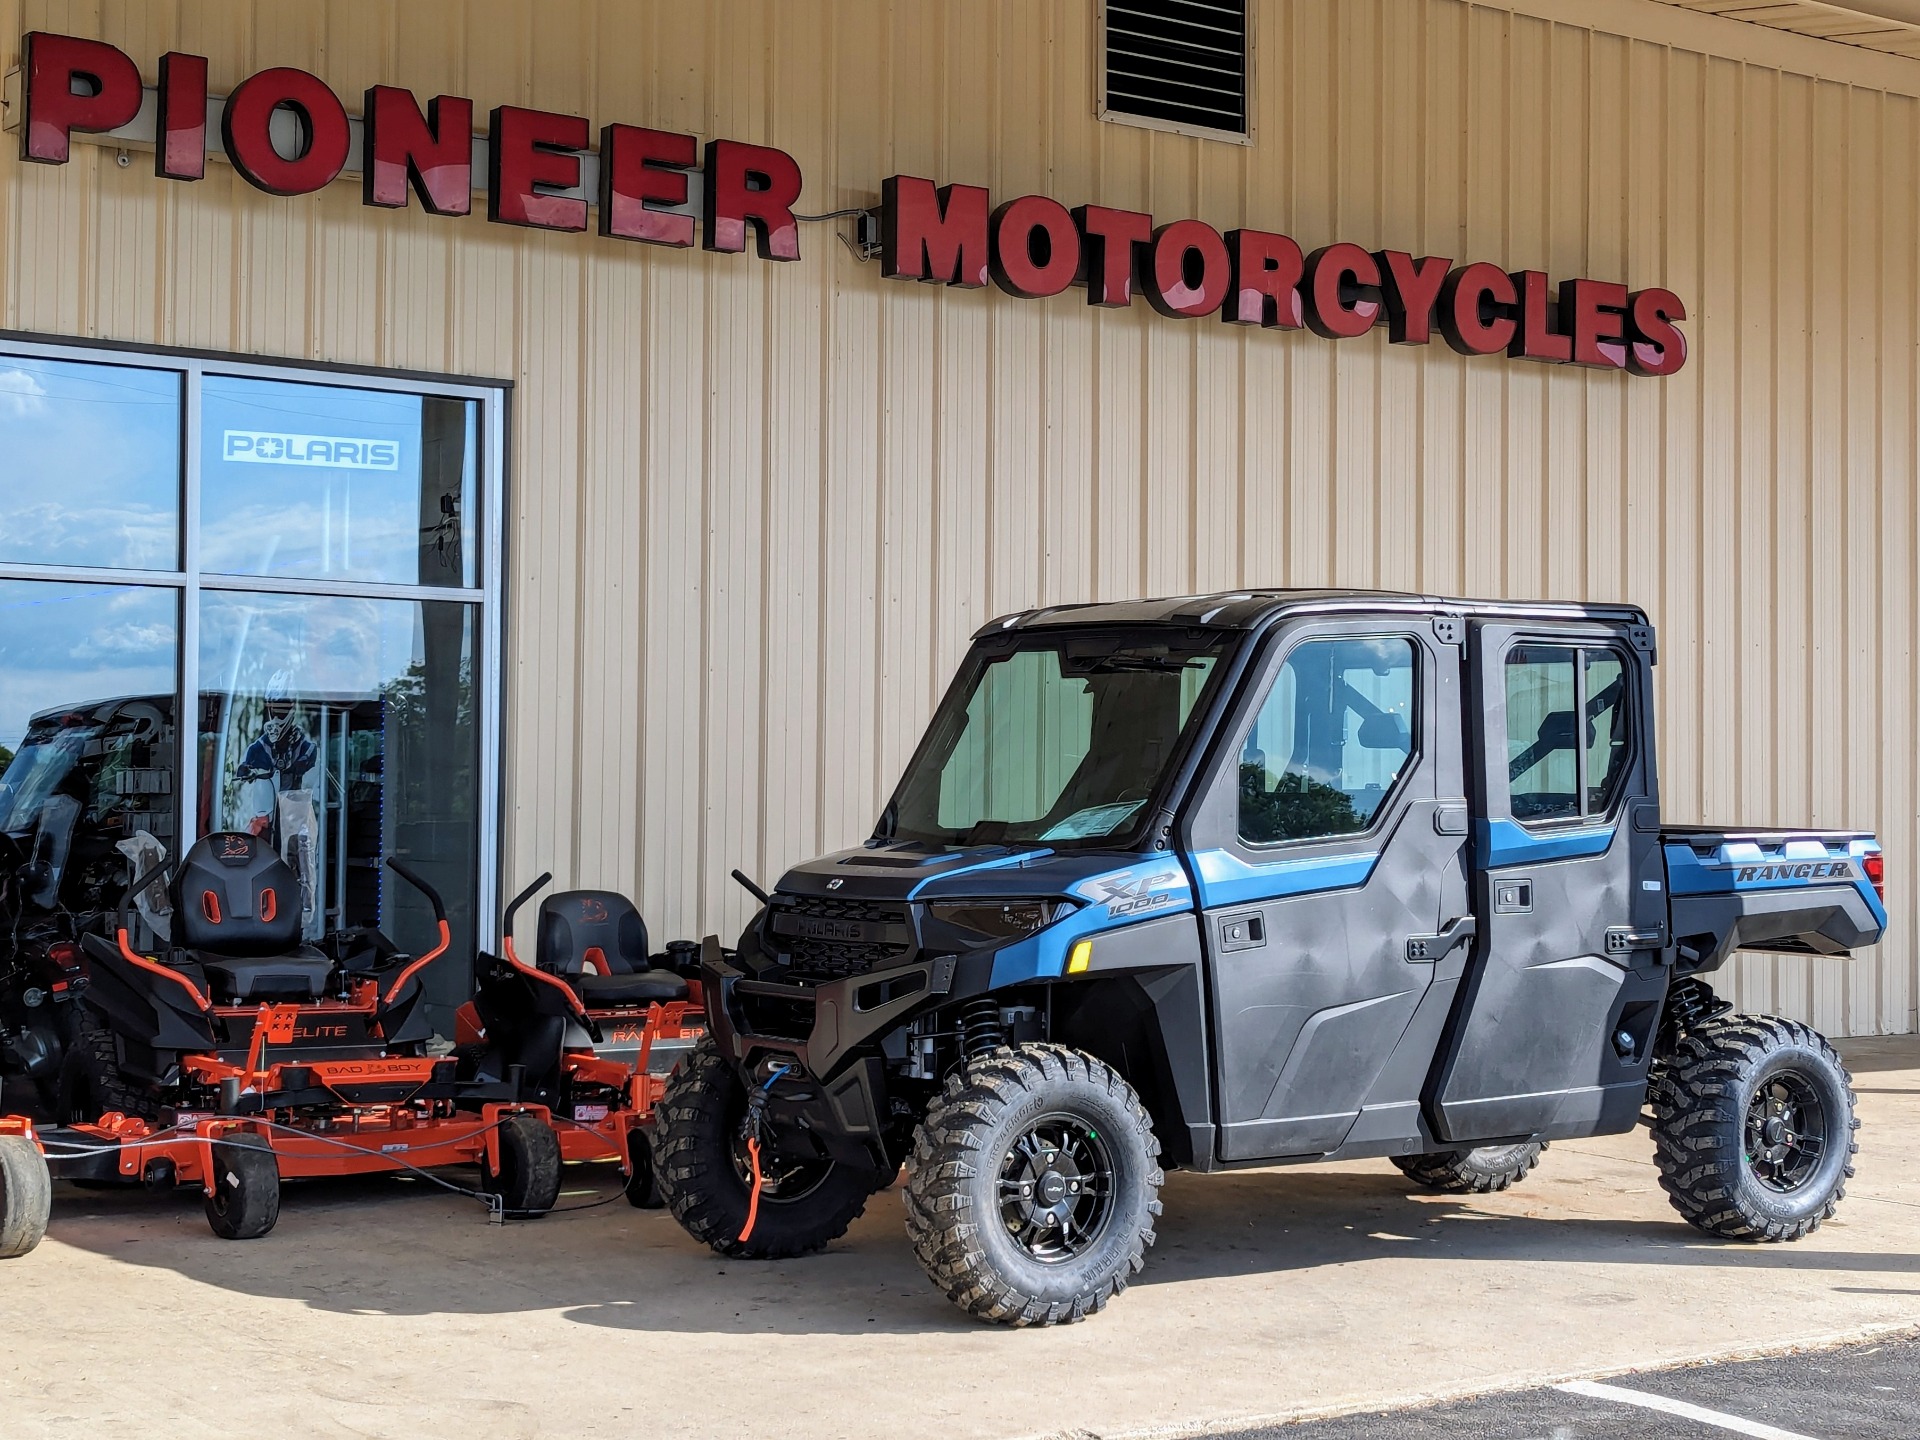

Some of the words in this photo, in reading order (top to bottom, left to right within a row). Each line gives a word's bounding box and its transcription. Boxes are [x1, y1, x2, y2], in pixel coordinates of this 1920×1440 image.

[19, 31, 802, 262] PIONEER
[882, 174, 1687, 376] MOTORCYCLES
[227, 435, 395, 466] POLARIS
[1737, 862, 1851, 882] RANGER
[1096, 872, 1177, 906] XP
[1109, 893, 1169, 916] 1000
[292, 1025, 348, 1038] ELITE
[326, 1066, 363, 1075] BAD
[387, 1064, 421, 1072] BOY
